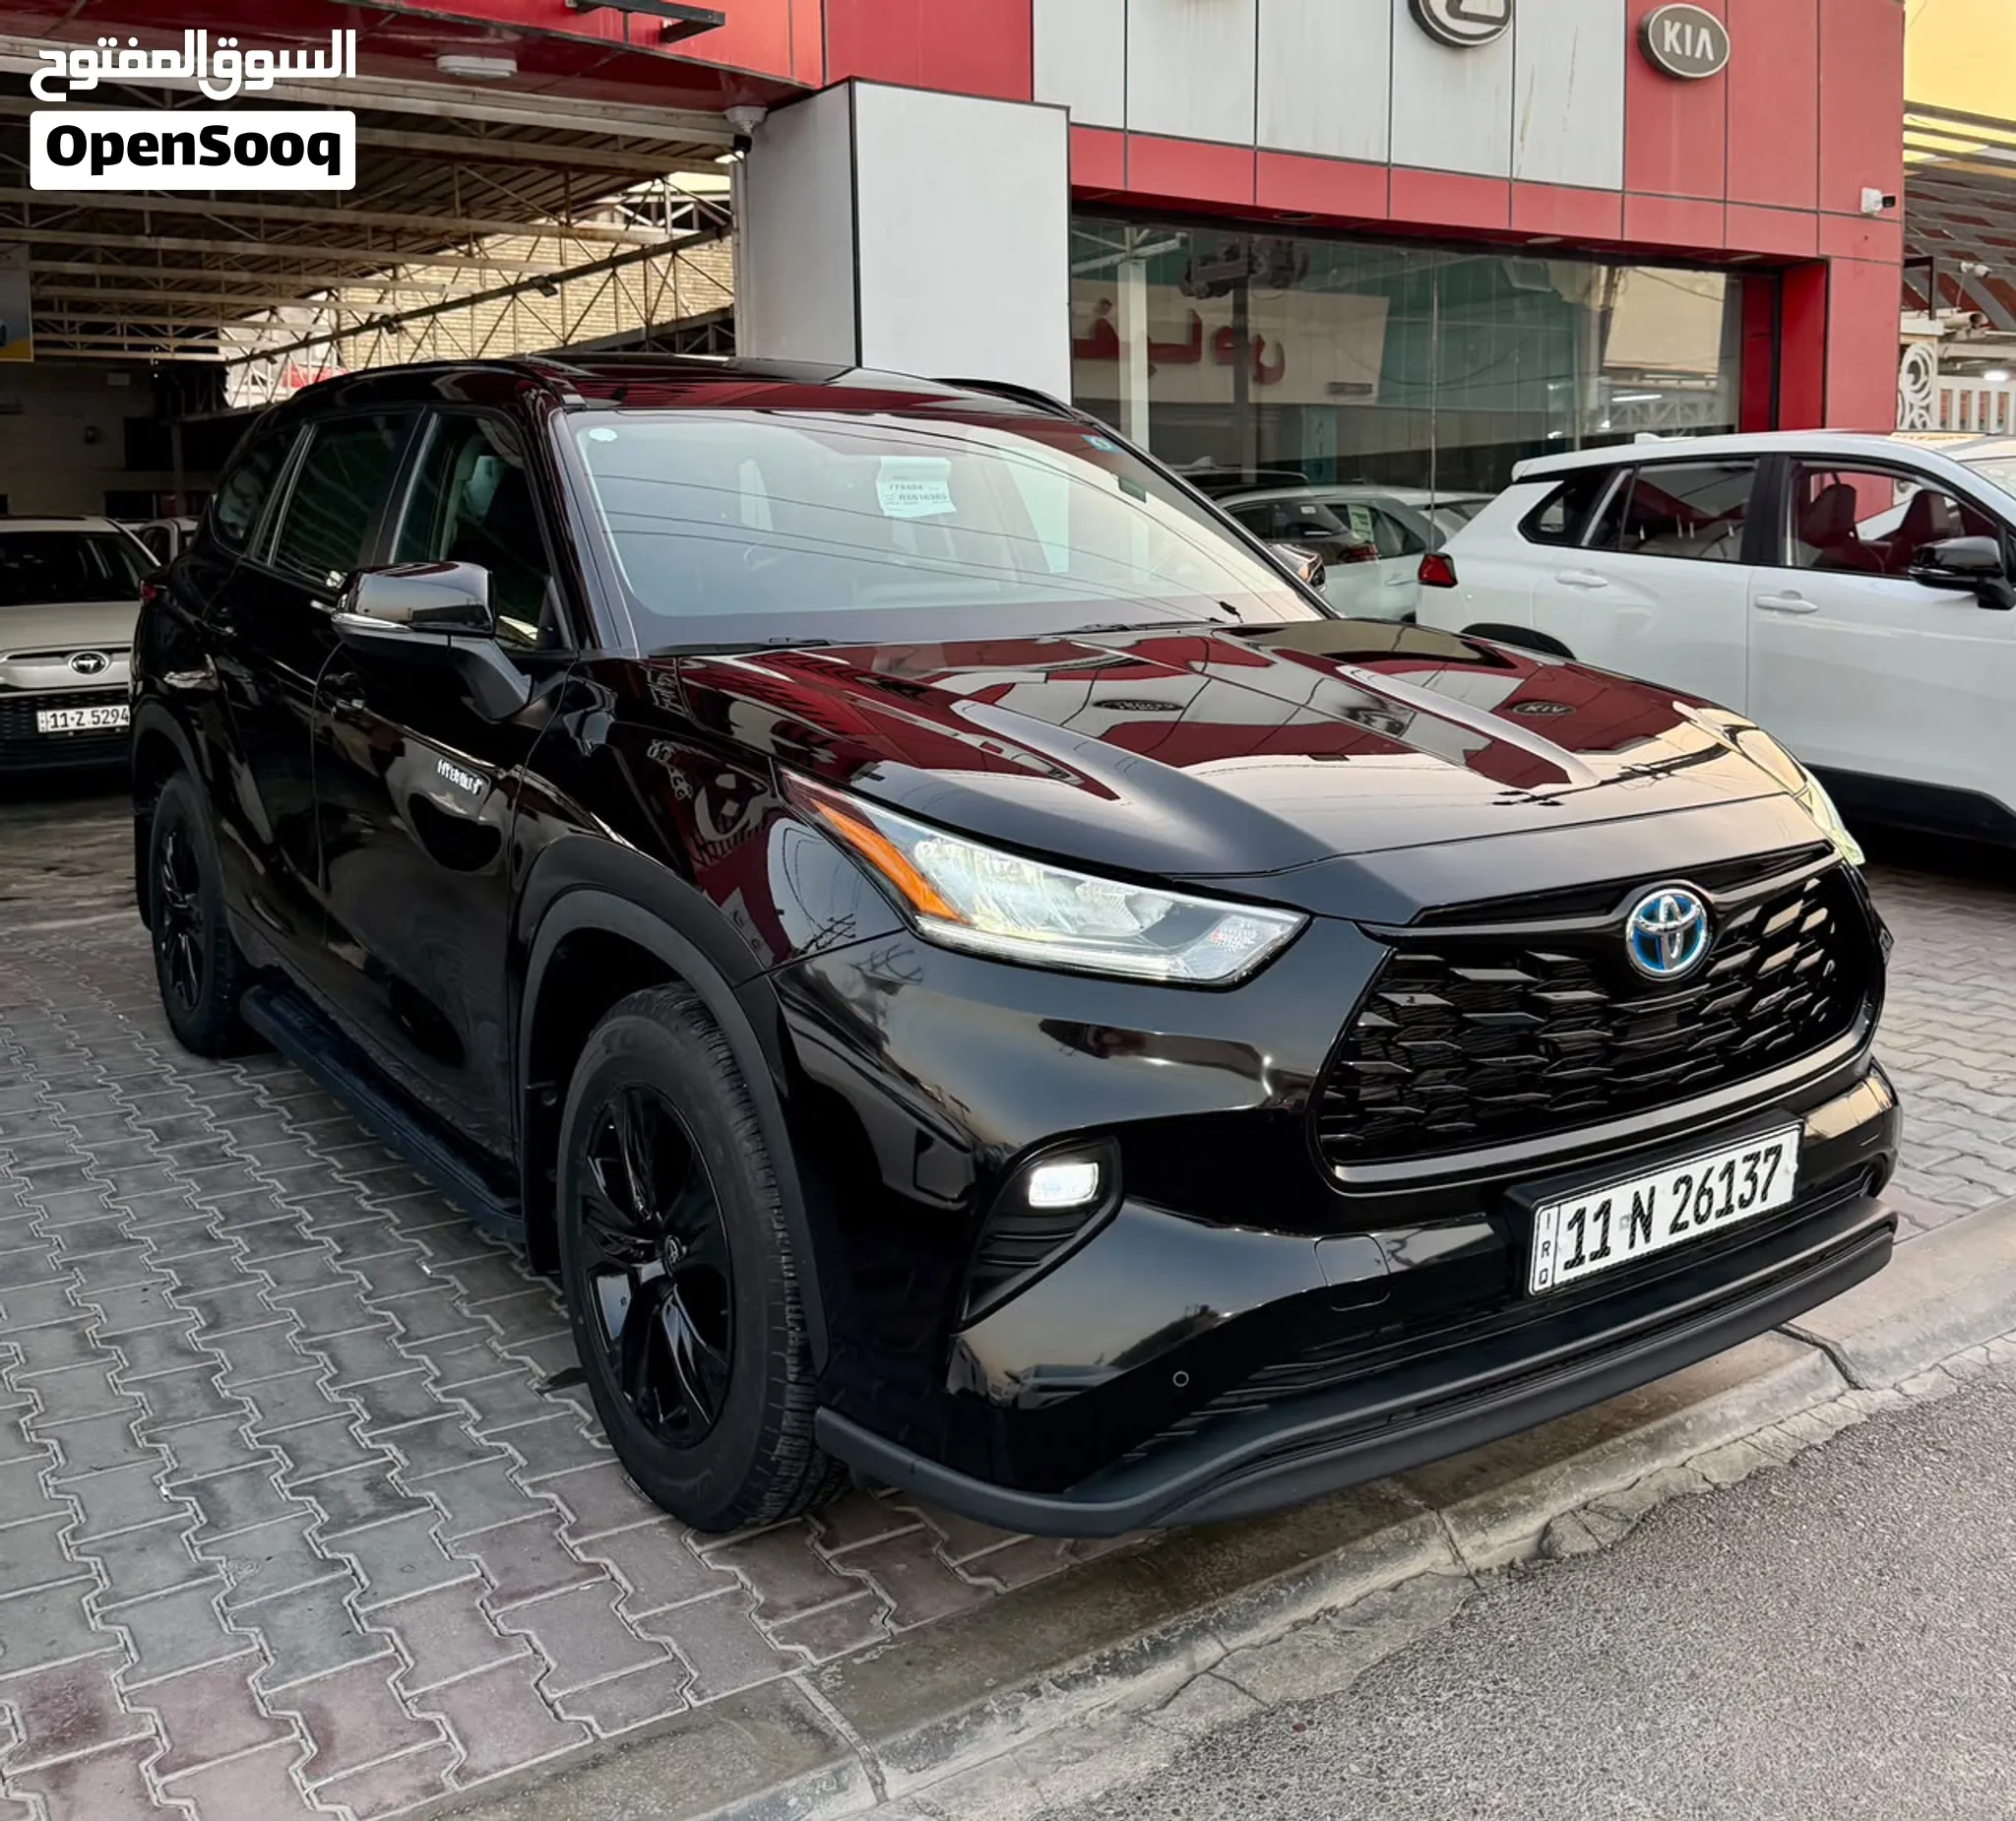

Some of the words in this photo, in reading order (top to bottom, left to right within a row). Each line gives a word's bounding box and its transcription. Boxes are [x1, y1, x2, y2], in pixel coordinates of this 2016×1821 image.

[1664, 20, 1715, 61] KIA
[49, 712, 70, 729] 11
[91, 707, 130, 726] 5294
[1563, 1198, 1613, 1271] 11
[1628, 1185, 1657, 1250] N
[1669, 1143, 1783, 1236] 26137
